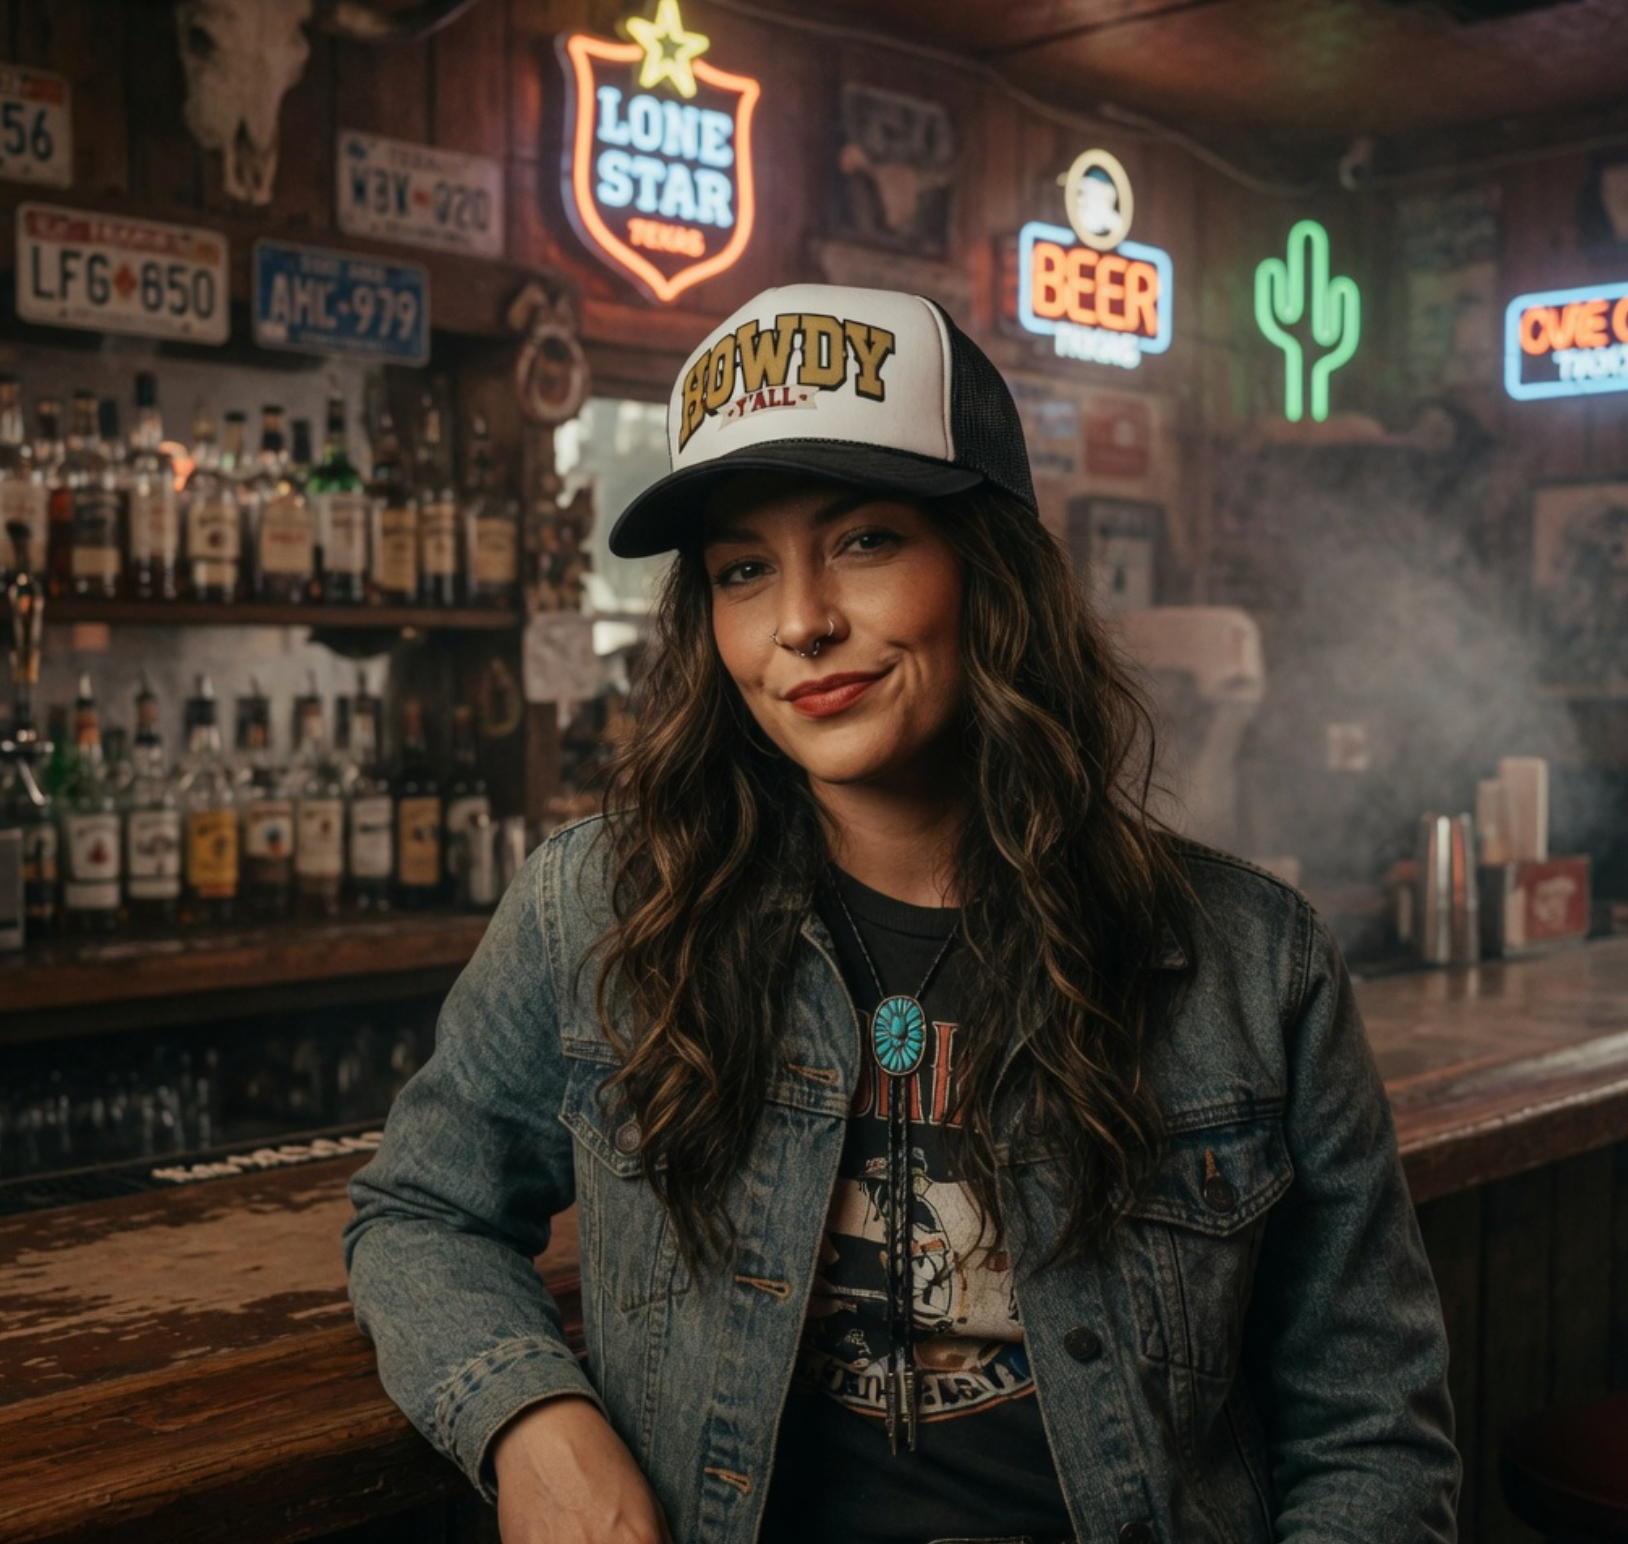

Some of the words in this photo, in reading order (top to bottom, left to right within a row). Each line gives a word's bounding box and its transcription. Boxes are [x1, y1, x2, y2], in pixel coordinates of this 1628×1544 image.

[597, 85, 734, 168] LONE
[597, 149, 734, 229] STAR
[1032, 241, 1160, 337] BEER
[679, 312, 896, 454] HOWDY
[736, 386, 796, 418] Y'ALL
